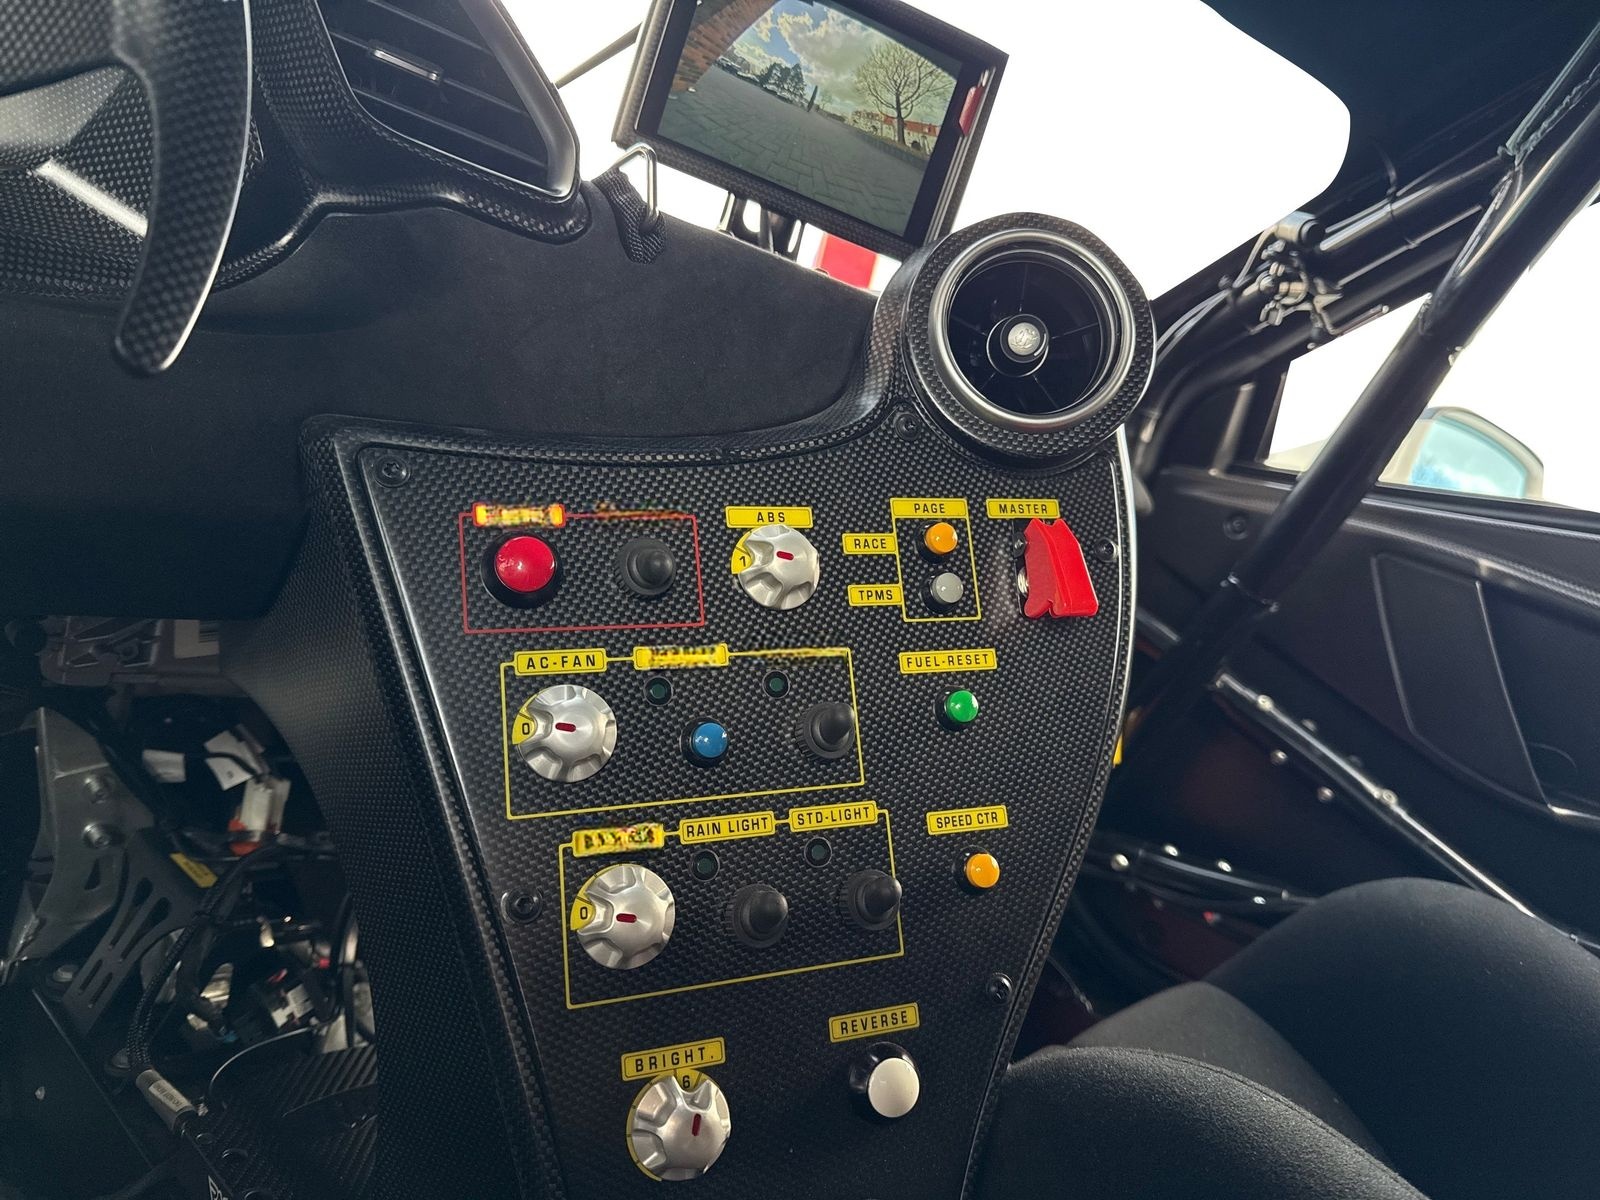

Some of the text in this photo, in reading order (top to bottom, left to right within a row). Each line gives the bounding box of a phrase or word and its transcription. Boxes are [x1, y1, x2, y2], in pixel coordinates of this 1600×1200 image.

[913, 502, 946, 514] PAGE
[998, 503, 1048, 515] MASTER
[757, 511, 786, 524] ABS
[853, 538, 887, 550] RACE
[738, 554, 747, 568] 1
[858, 589, 893, 601] TPMS
[526, 654, 596, 669] AC-FAN
[906, 653, 989, 669] FUEL-RESET
[797, 806, 871, 825] STD-LIGHT
[936, 811, 998, 829] SPEED CTR
[686, 816, 768, 837] RAIN LIGHT
[840, 1010, 909, 1035] REVERSE
[635, 1046, 716, 1073] BRIGHT.
[682, 1075, 691, 1089] 6
